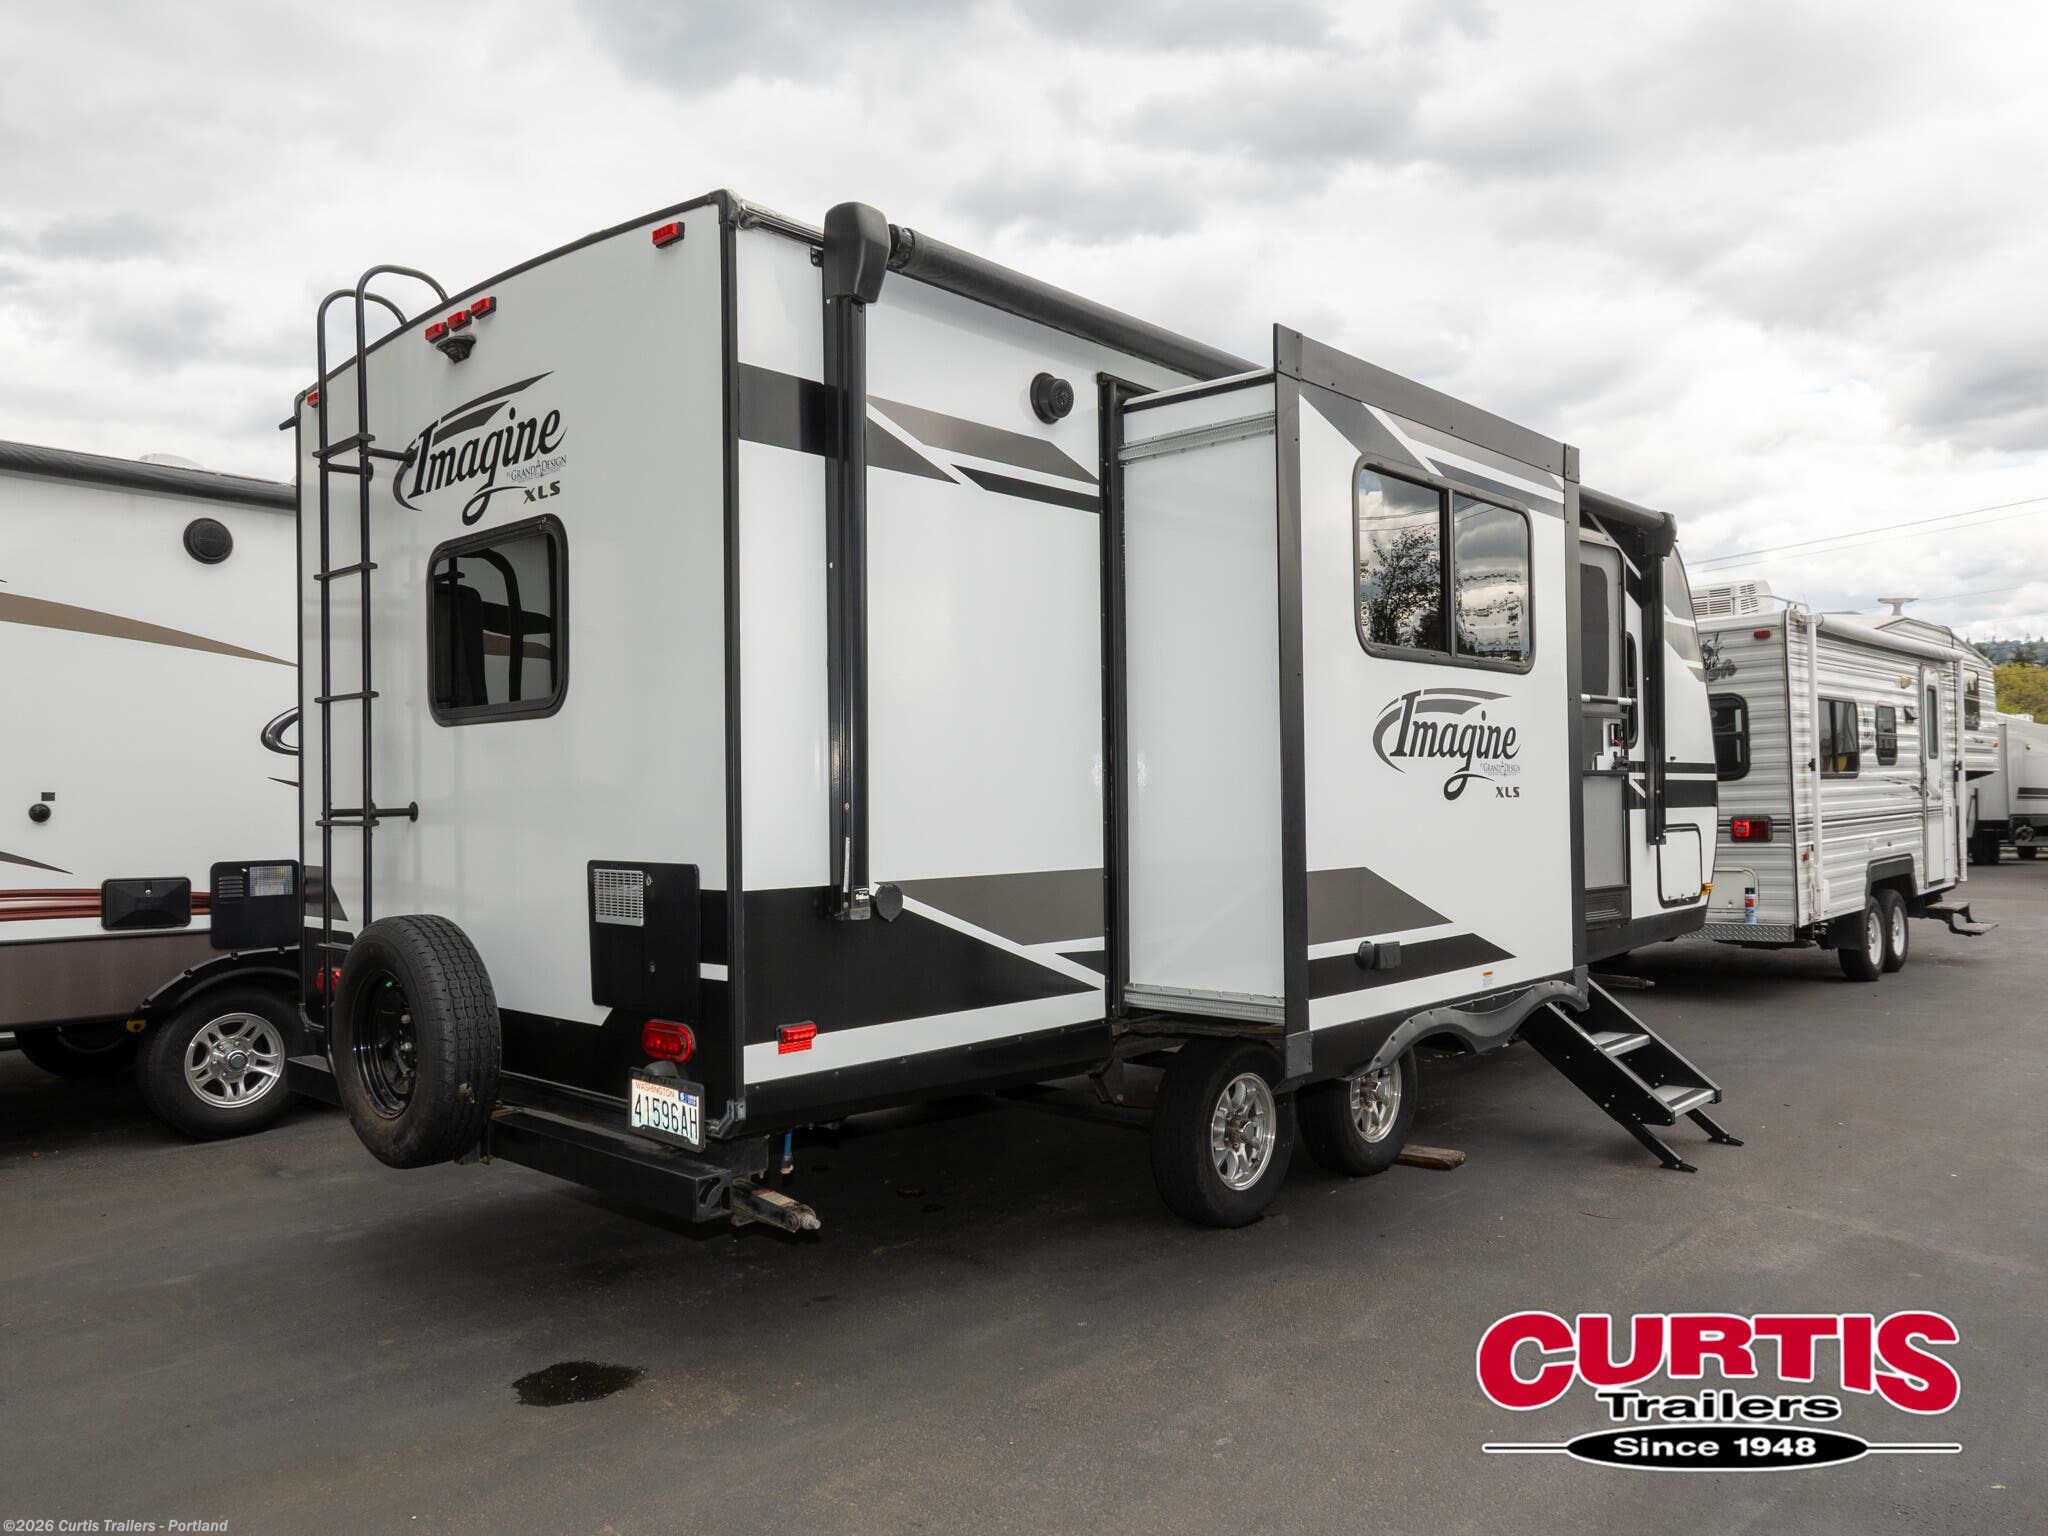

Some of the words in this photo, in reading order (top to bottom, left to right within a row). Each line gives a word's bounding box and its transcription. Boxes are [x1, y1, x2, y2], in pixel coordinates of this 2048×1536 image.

[407, 407, 568, 526] Imagine
[511, 465, 535, 481] GRAND
[541, 455, 567, 471] DESIGN
[523, 480, 561, 504] XLS
[1389, 690, 1521, 801] Imagine
[1496, 786, 1520, 798] XLS
[635, 1081, 675, 1099] WASHINGTON
[634, 1093, 697, 1140] 41596AH
